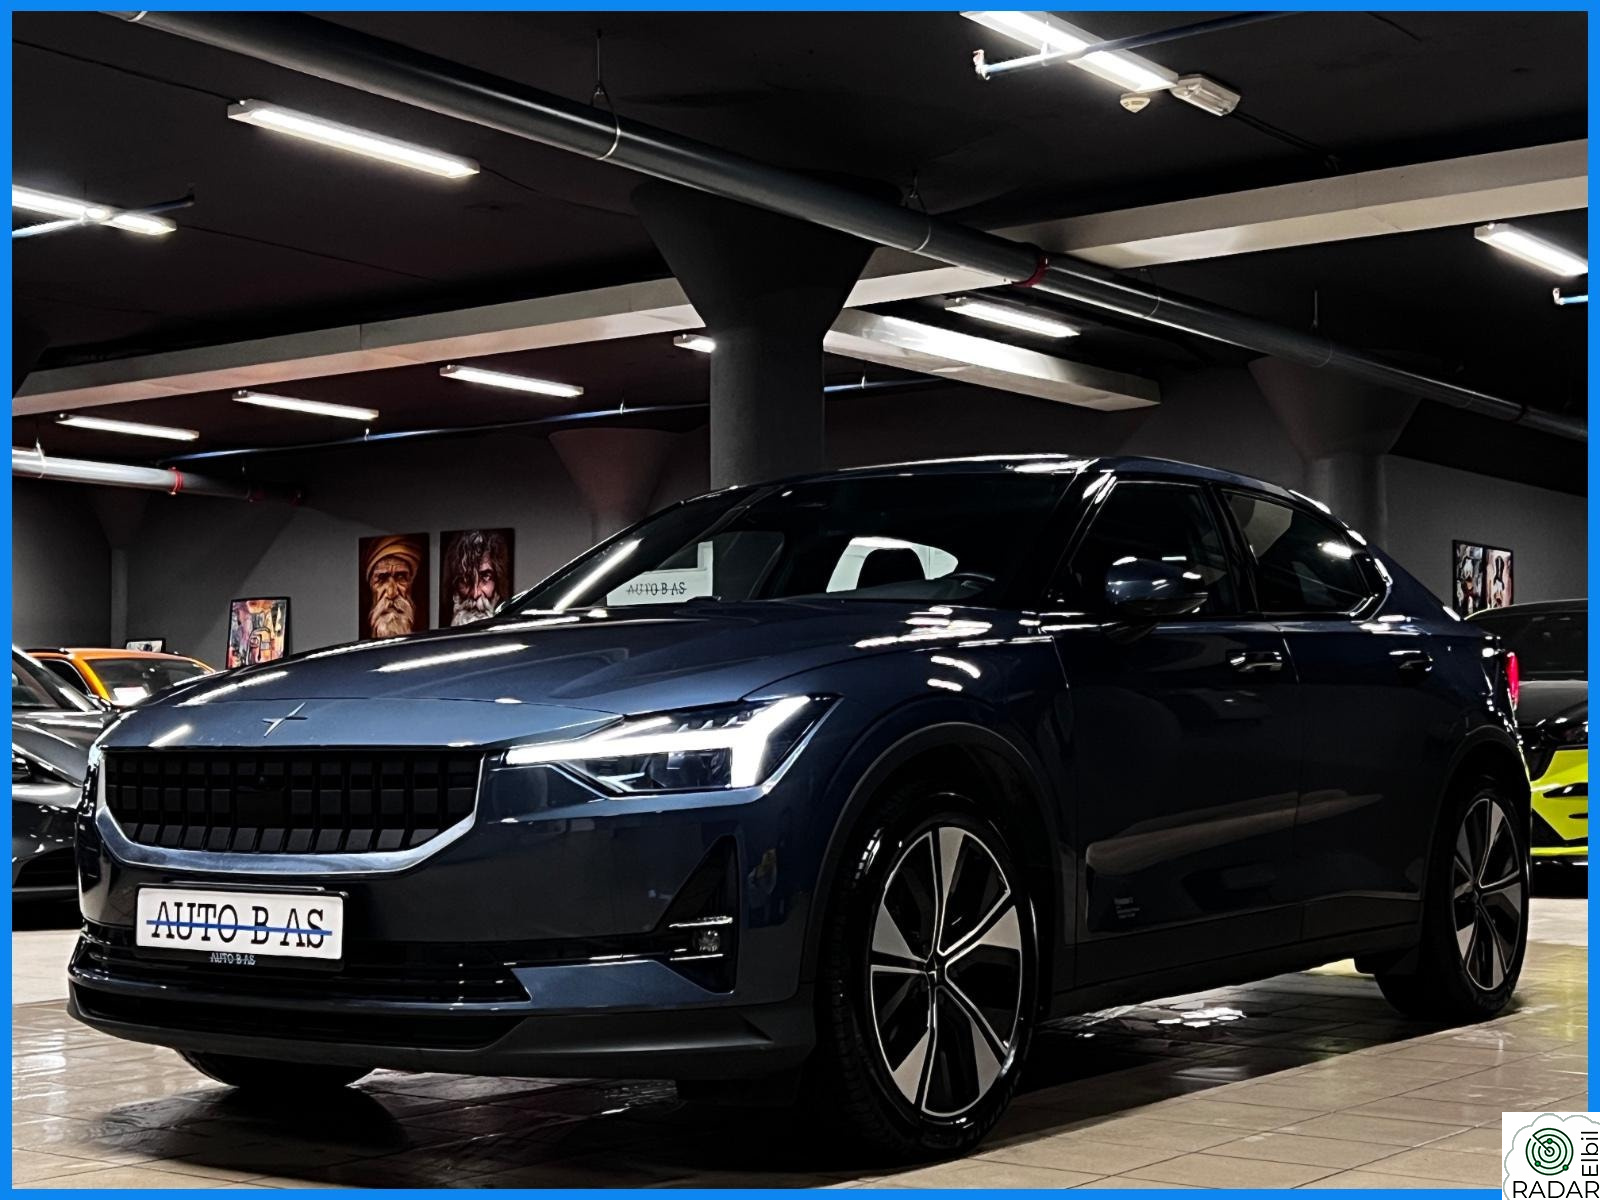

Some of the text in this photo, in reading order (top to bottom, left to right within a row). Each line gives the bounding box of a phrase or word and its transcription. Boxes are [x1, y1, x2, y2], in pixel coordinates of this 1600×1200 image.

[151, 901, 325, 949] AUTO B AS
[210, 952, 234, 964] AUTO
